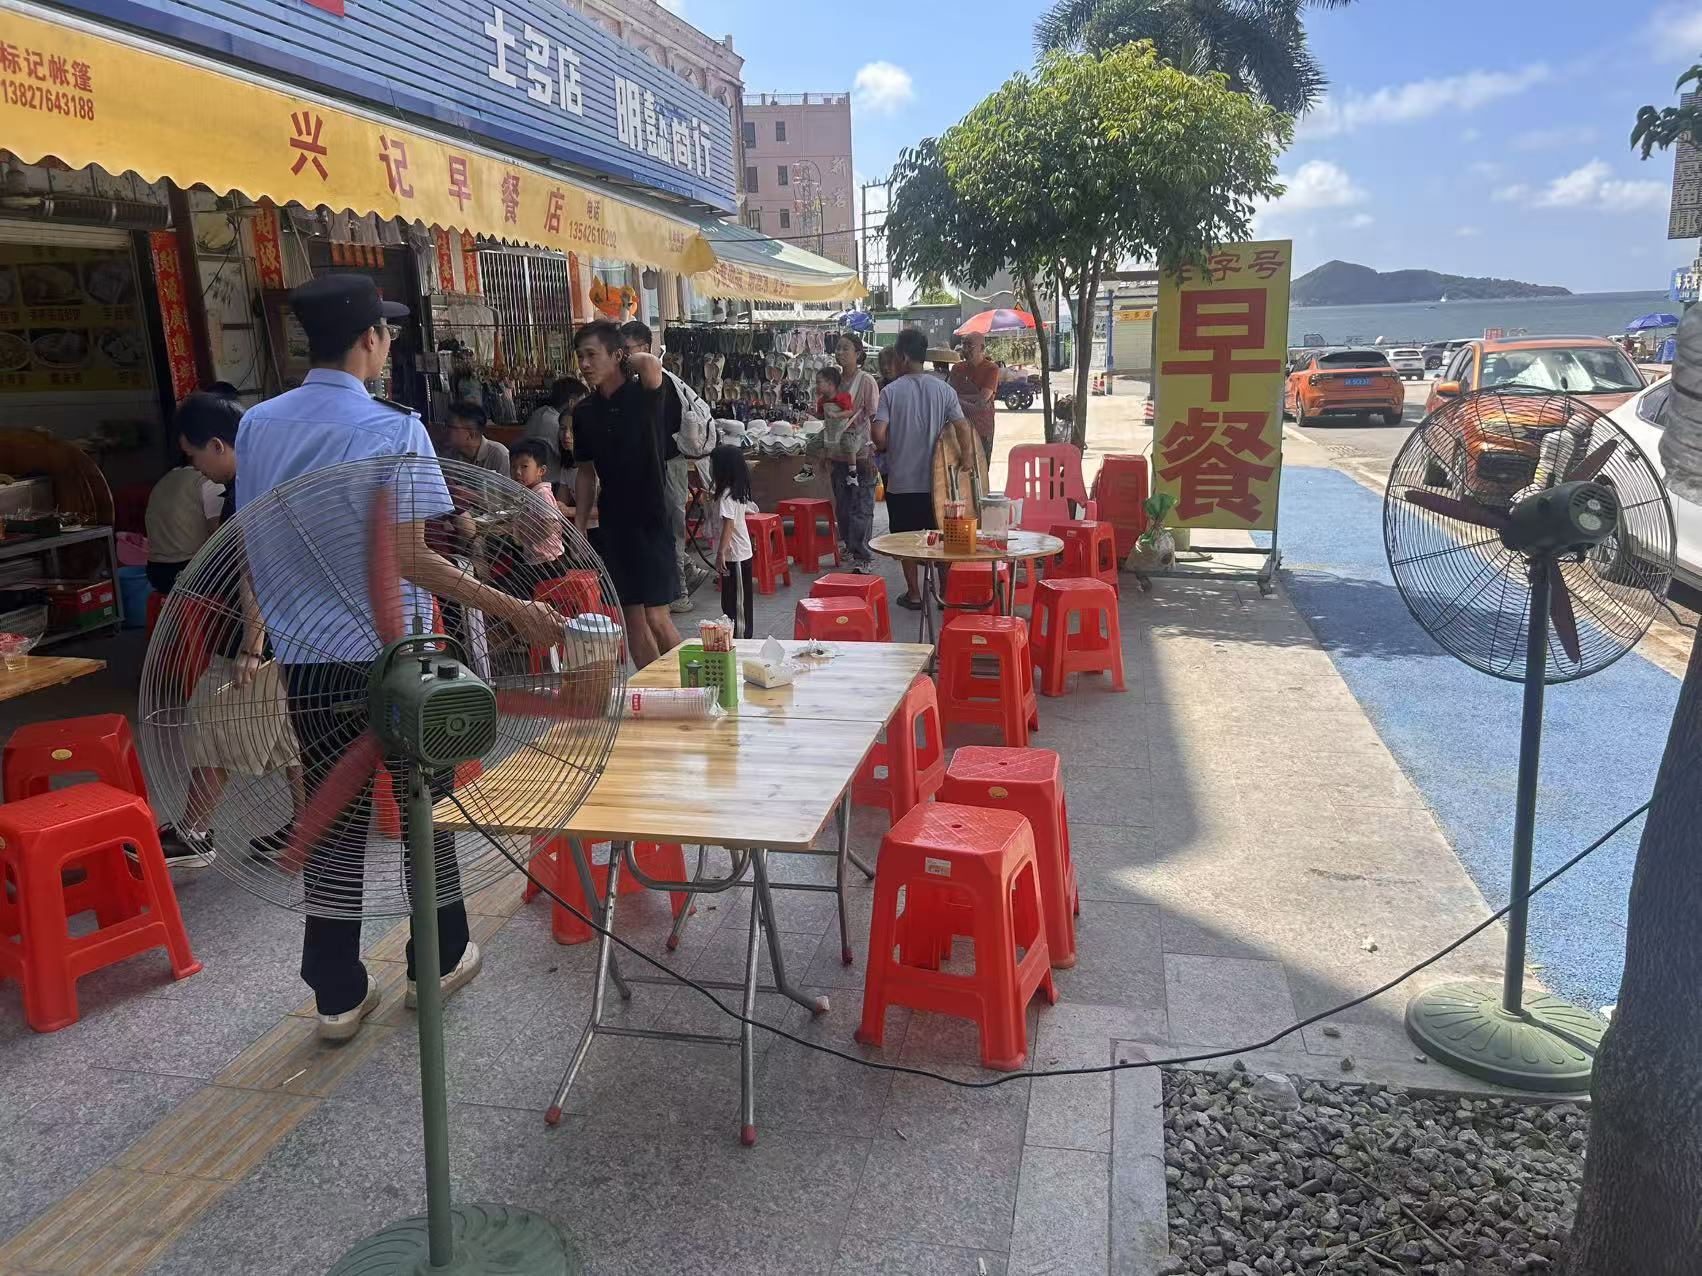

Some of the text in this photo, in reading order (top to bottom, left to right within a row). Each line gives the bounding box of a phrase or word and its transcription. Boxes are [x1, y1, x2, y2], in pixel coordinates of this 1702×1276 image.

[1, 79, 94, 121] 13827643188
[484, 6, 583, 118] 士多店
[289, 110, 565, 234] 兴记早餐店
[1159, 287, 1282, 524] 早餐
